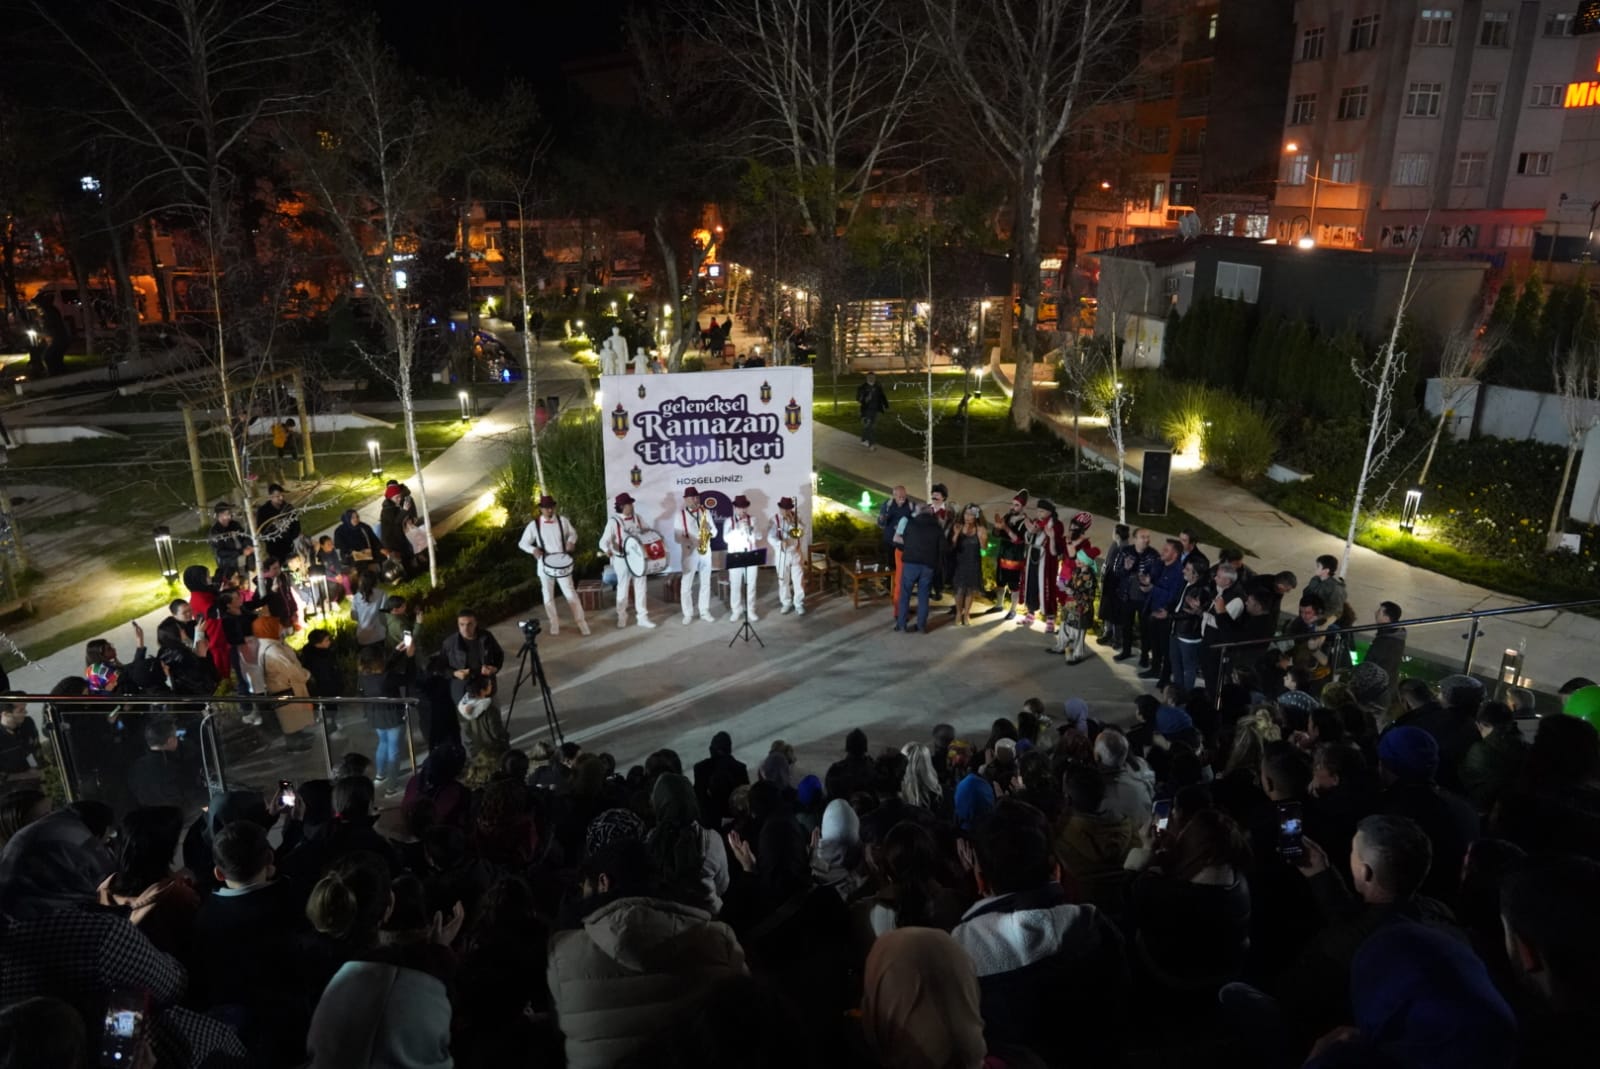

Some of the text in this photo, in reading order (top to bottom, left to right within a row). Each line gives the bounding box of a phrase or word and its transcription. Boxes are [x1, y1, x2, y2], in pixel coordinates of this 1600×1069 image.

[661, 395, 746, 418] geleneksel
[636, 411, 778, 441] Ramazan
[636, 436, 782, 465] Etkinlikleri
